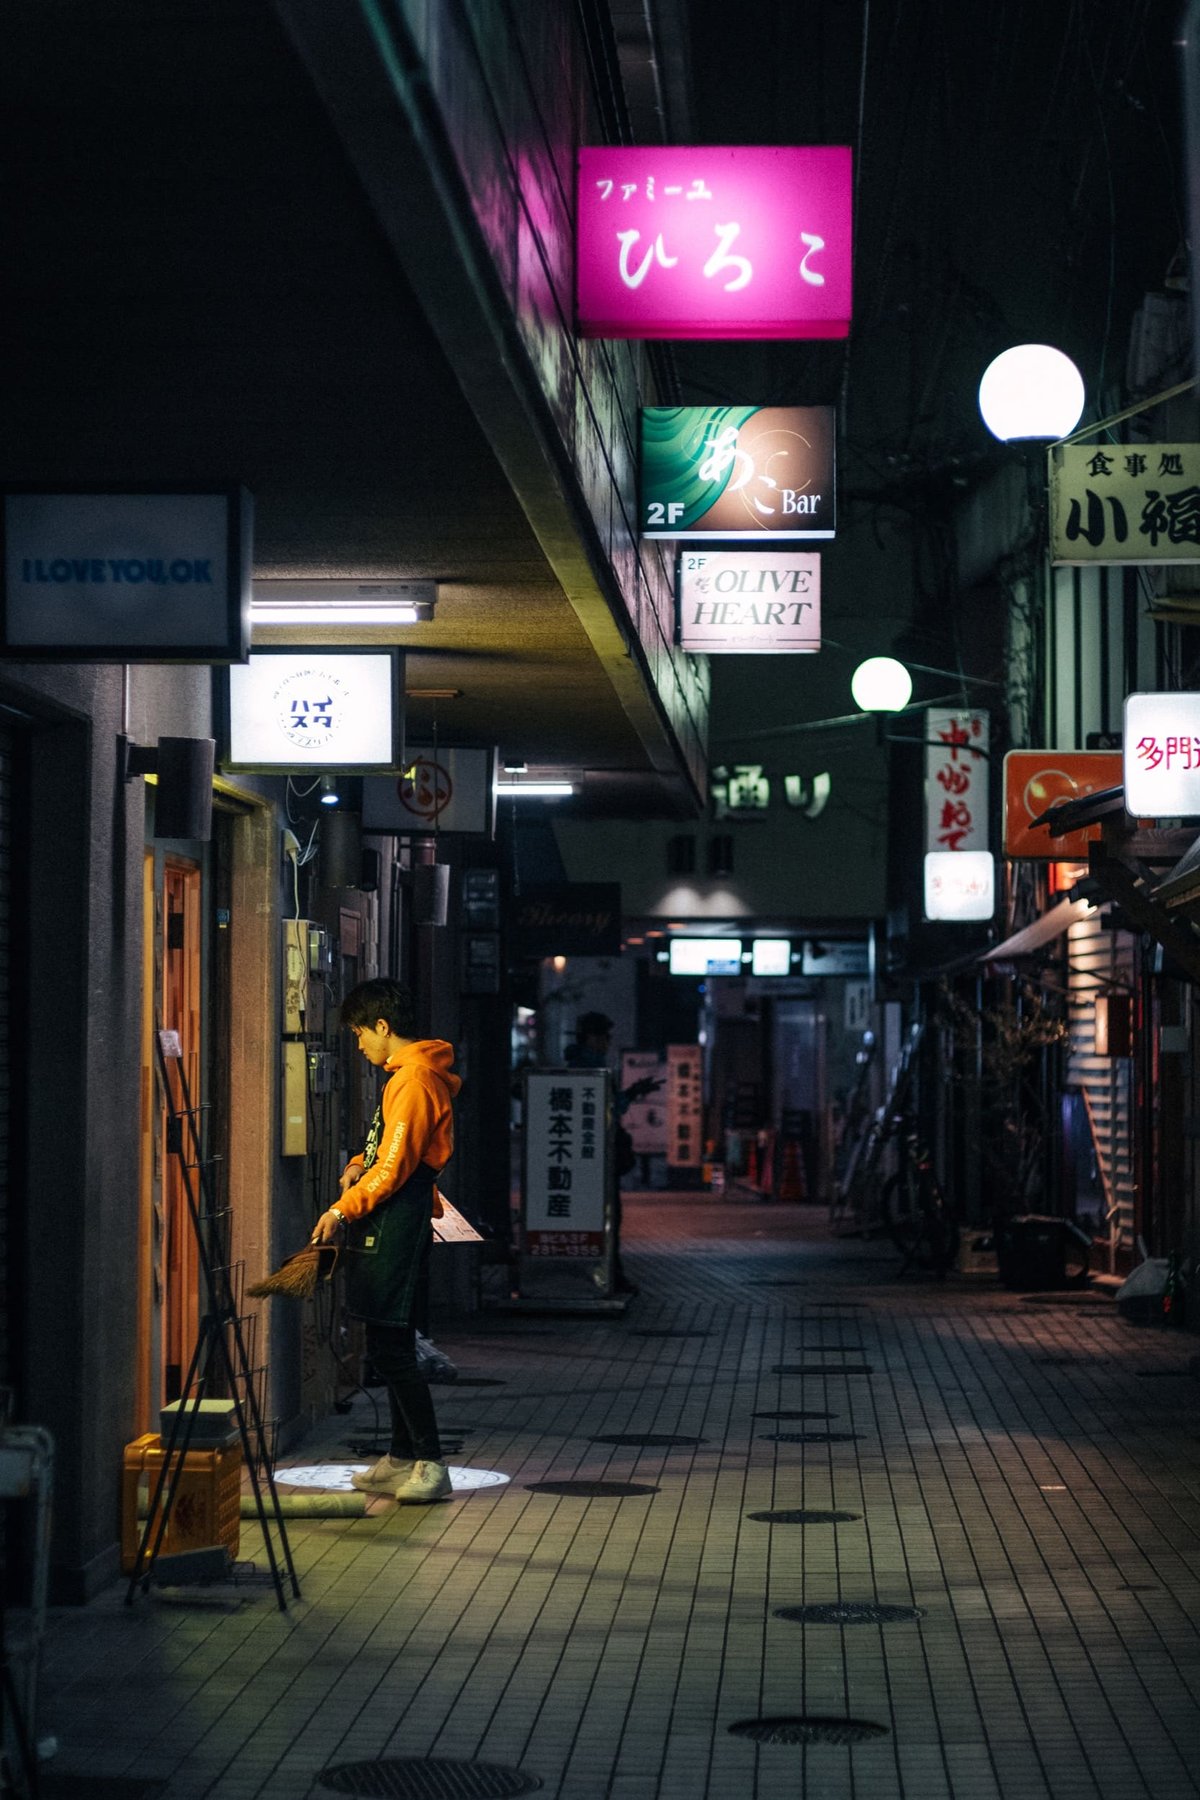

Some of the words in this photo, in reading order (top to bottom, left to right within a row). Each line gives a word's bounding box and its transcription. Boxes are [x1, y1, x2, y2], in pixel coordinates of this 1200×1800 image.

[597, 176, 712, 200] ファミーユ
[617, 222, 825, 292] ひろこ
[1086, 451, 1184, 478] 食事処
[647, 502, 685, 525] 2F
[782, 489, 821, 514] Bar
[35, 558, 106, 583] LOVE
[688, 558, 707, 570] 2F
[715, 570, 813, 593] OLIVE
[692, 602, 813, 625] HEART
[1136, 737, 1200, 771] 多門
[382, 1120, 406, 1169] HIGHBALL
[547, 1086, 573, 1217] 橋本不動産
[367, 1168, 390, 1193] STAND
